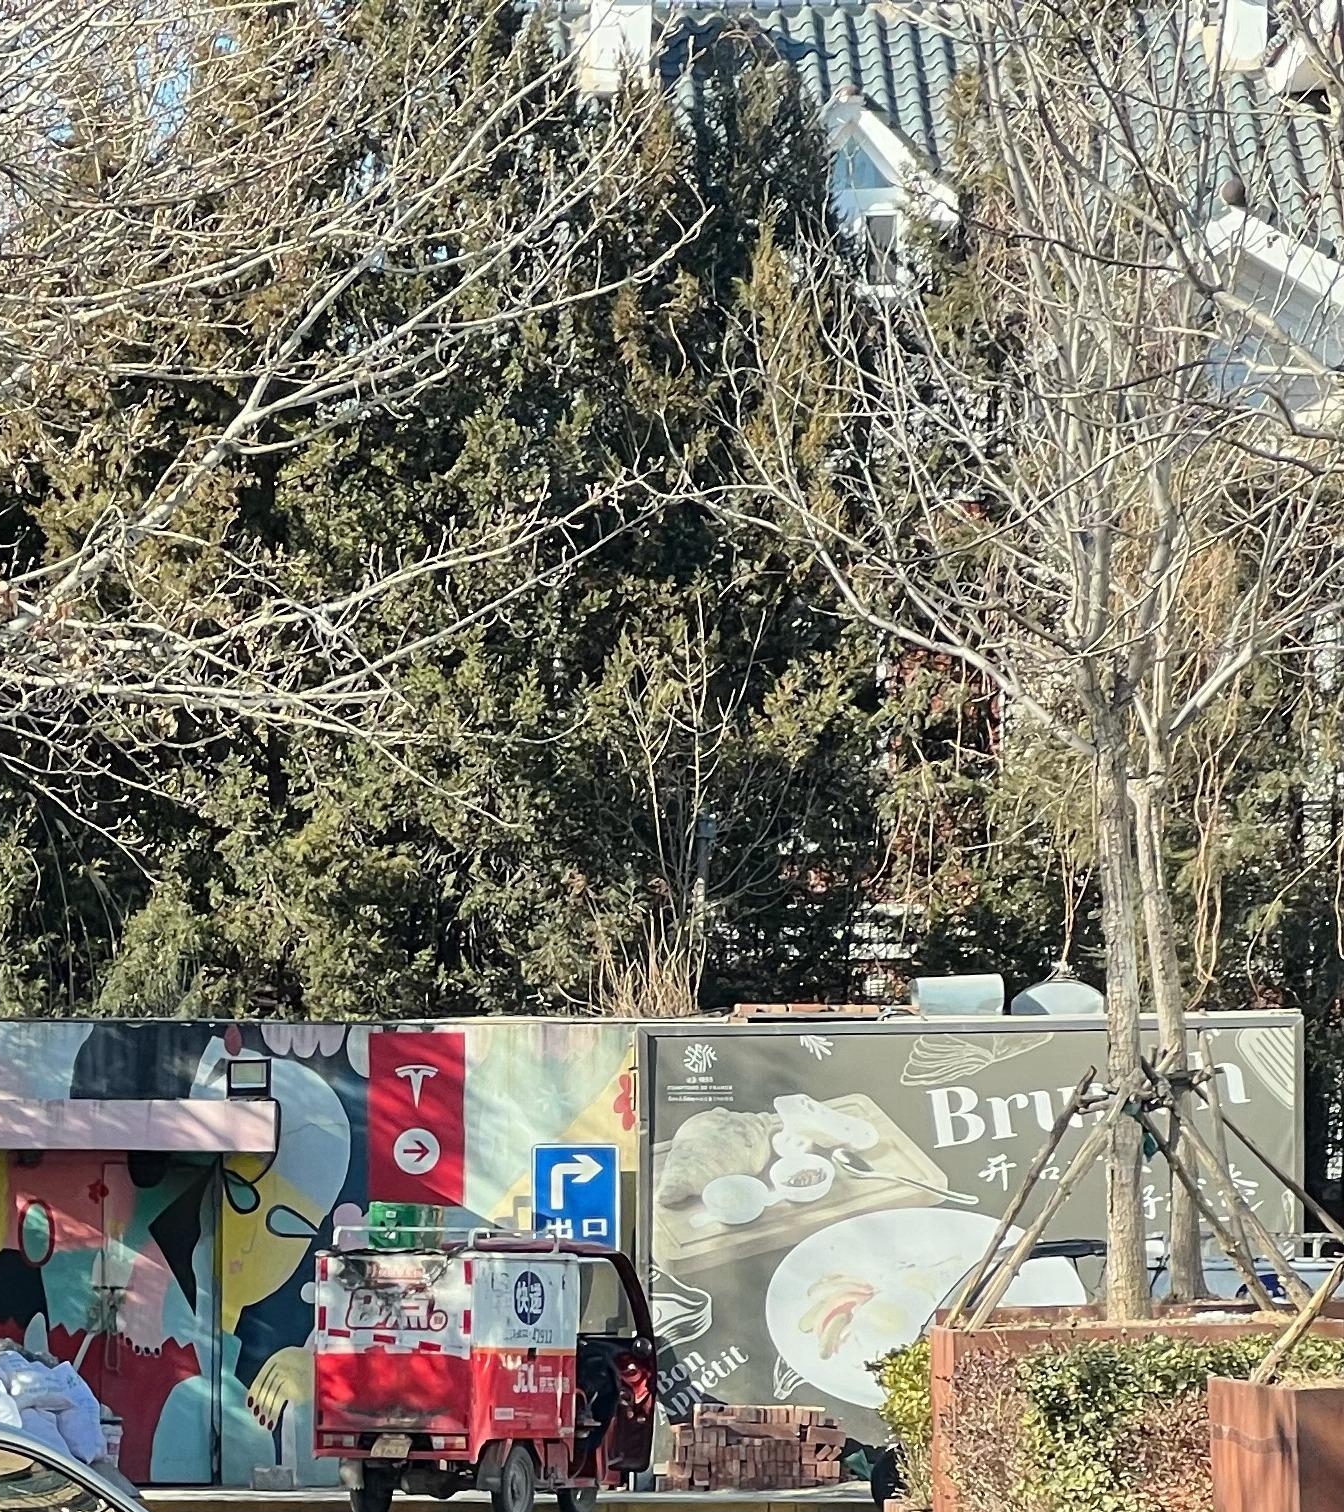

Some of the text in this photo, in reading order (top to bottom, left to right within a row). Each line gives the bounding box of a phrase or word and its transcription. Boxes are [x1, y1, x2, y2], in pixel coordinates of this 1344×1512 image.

[925, 1050, 1252, 1149] Bruh
[545, 1217, 608, 1240] 出口
[656, 1351, 706, 1395] Bon
[656, 1345, 750, 1426] Appétit
